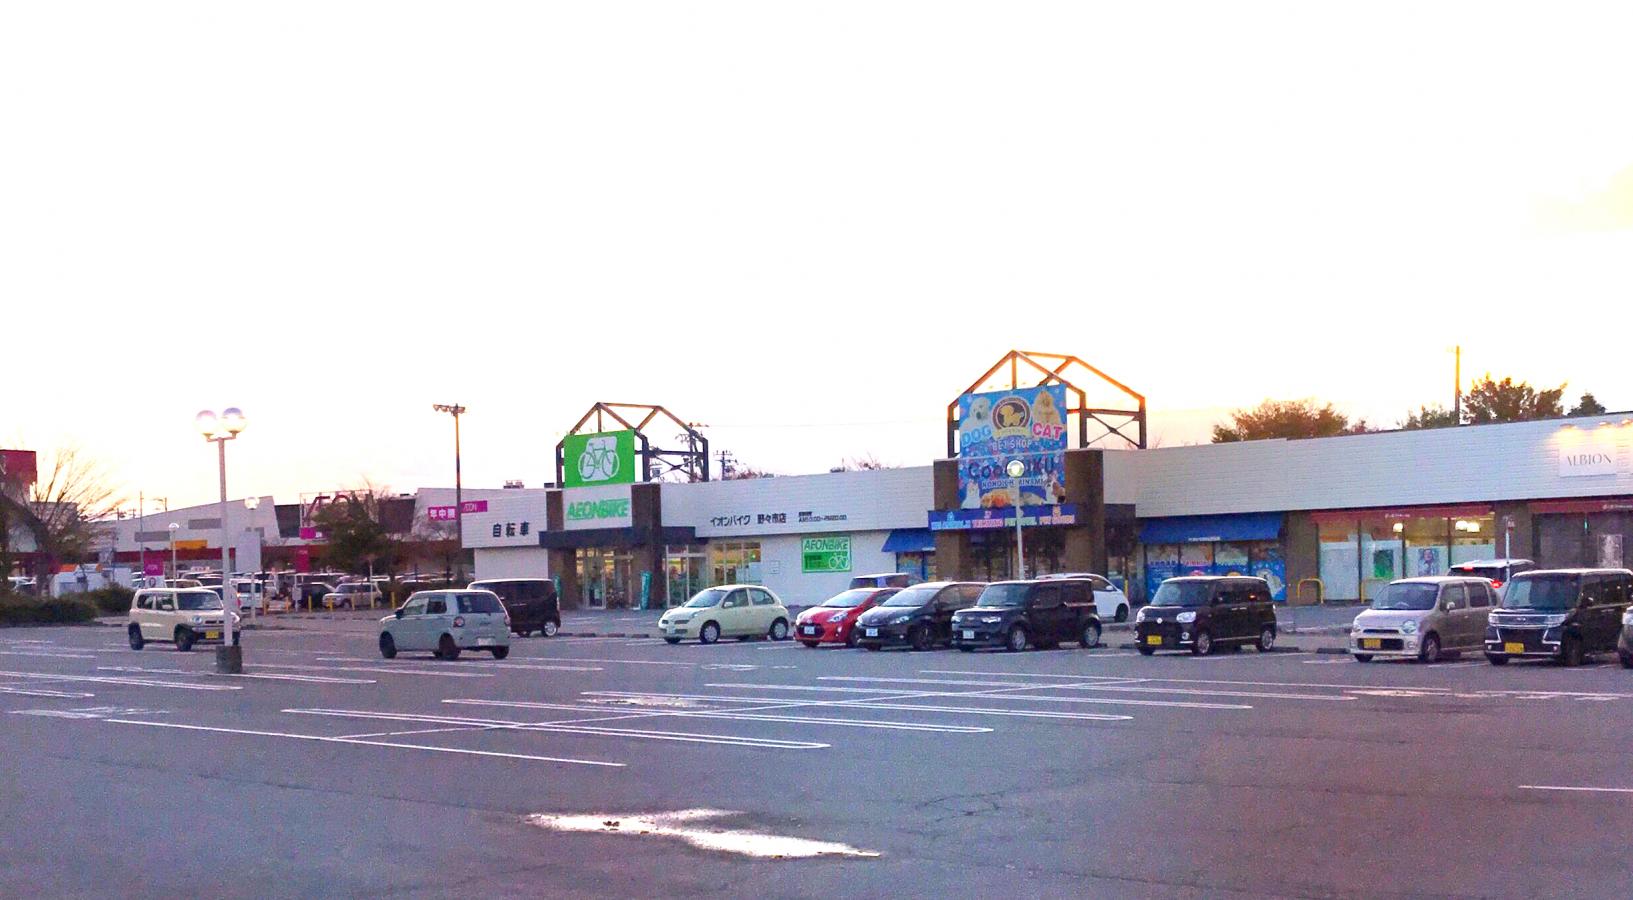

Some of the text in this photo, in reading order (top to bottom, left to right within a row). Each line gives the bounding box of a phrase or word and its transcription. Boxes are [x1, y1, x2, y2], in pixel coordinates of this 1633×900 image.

[961, 424, 992, 447] DOG
[1032, 422, 1063, 440] CAT
[1011, 439, 1032, 449] SHOP
[1567, 453, 1612, 466] ALBION
[710, 514, 751, 527] イオンバイク
[757, 513, 787, 524] 野々市店
[492, 521, 530, 538] 自転車
